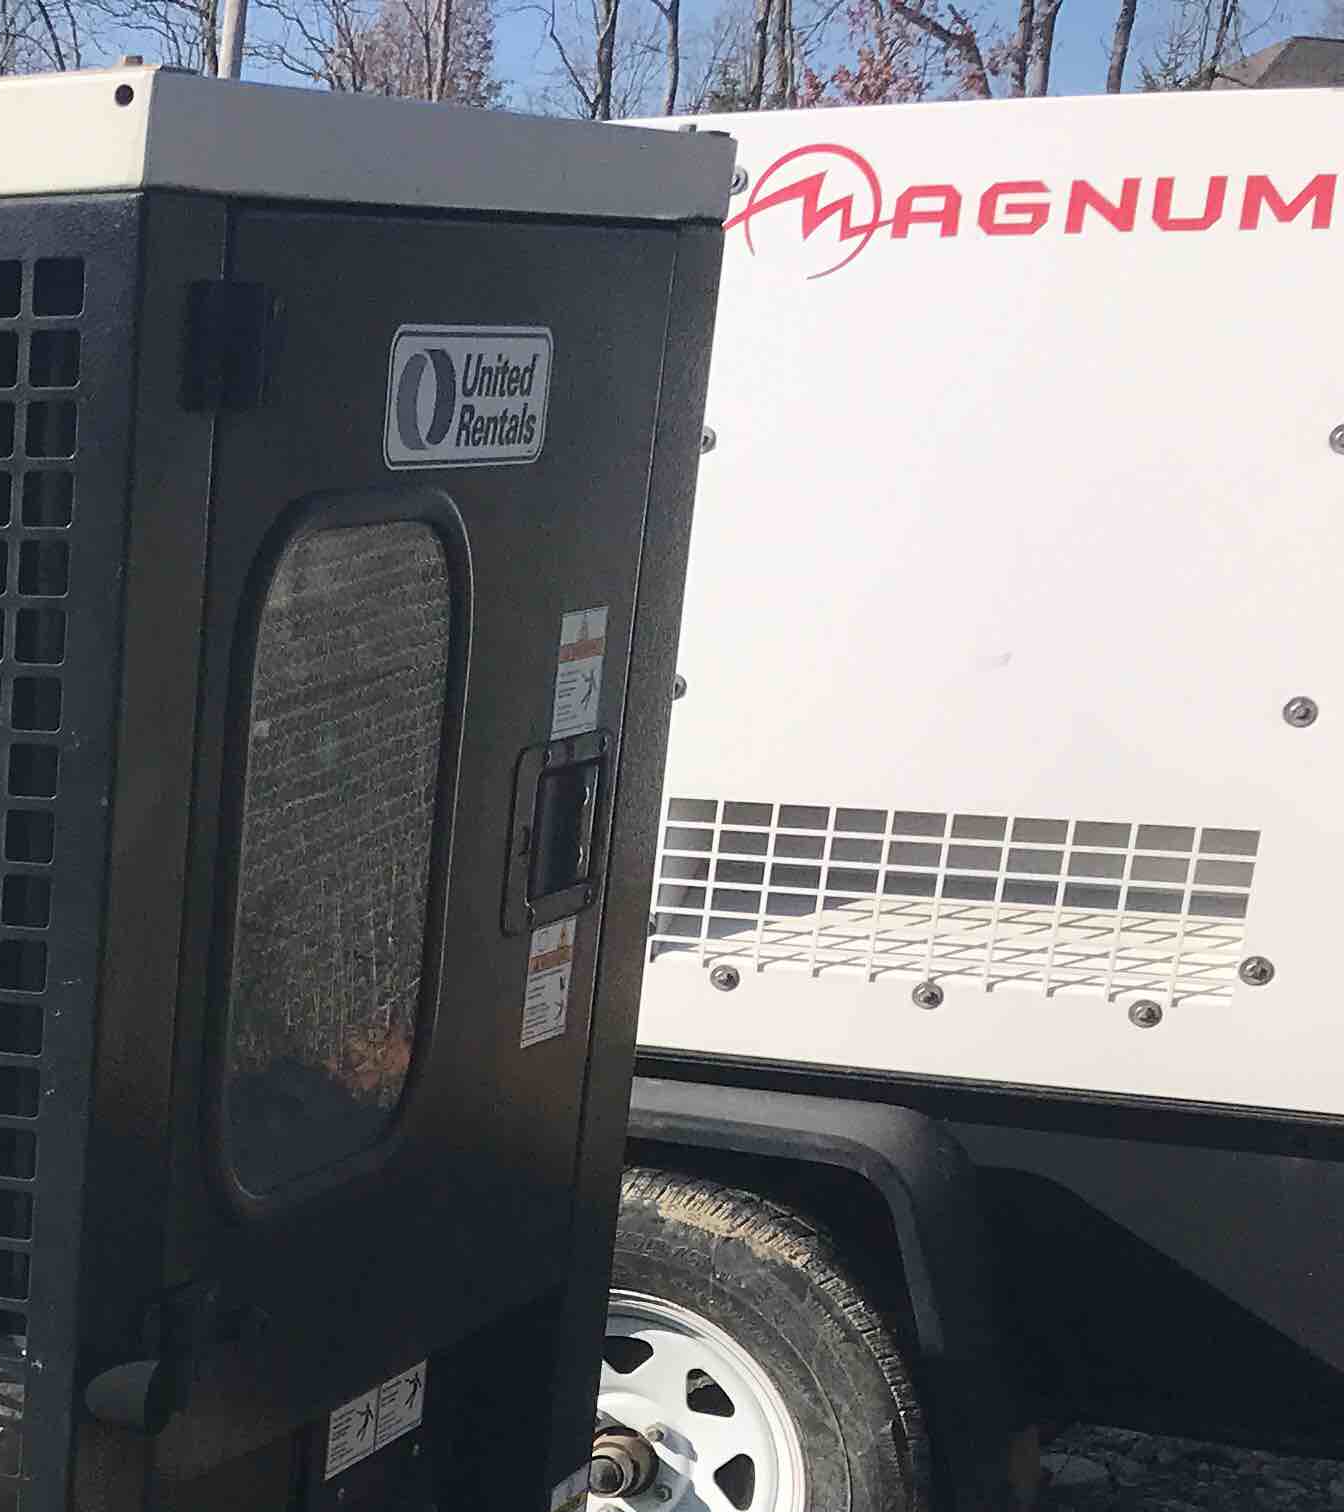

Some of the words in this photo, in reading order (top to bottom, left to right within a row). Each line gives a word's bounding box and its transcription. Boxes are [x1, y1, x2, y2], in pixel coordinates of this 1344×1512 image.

[722, 166, 1338, 243] MAGNUM
[462, 353, 540, 398] United
[455, 402, 537, 447] Rentals
